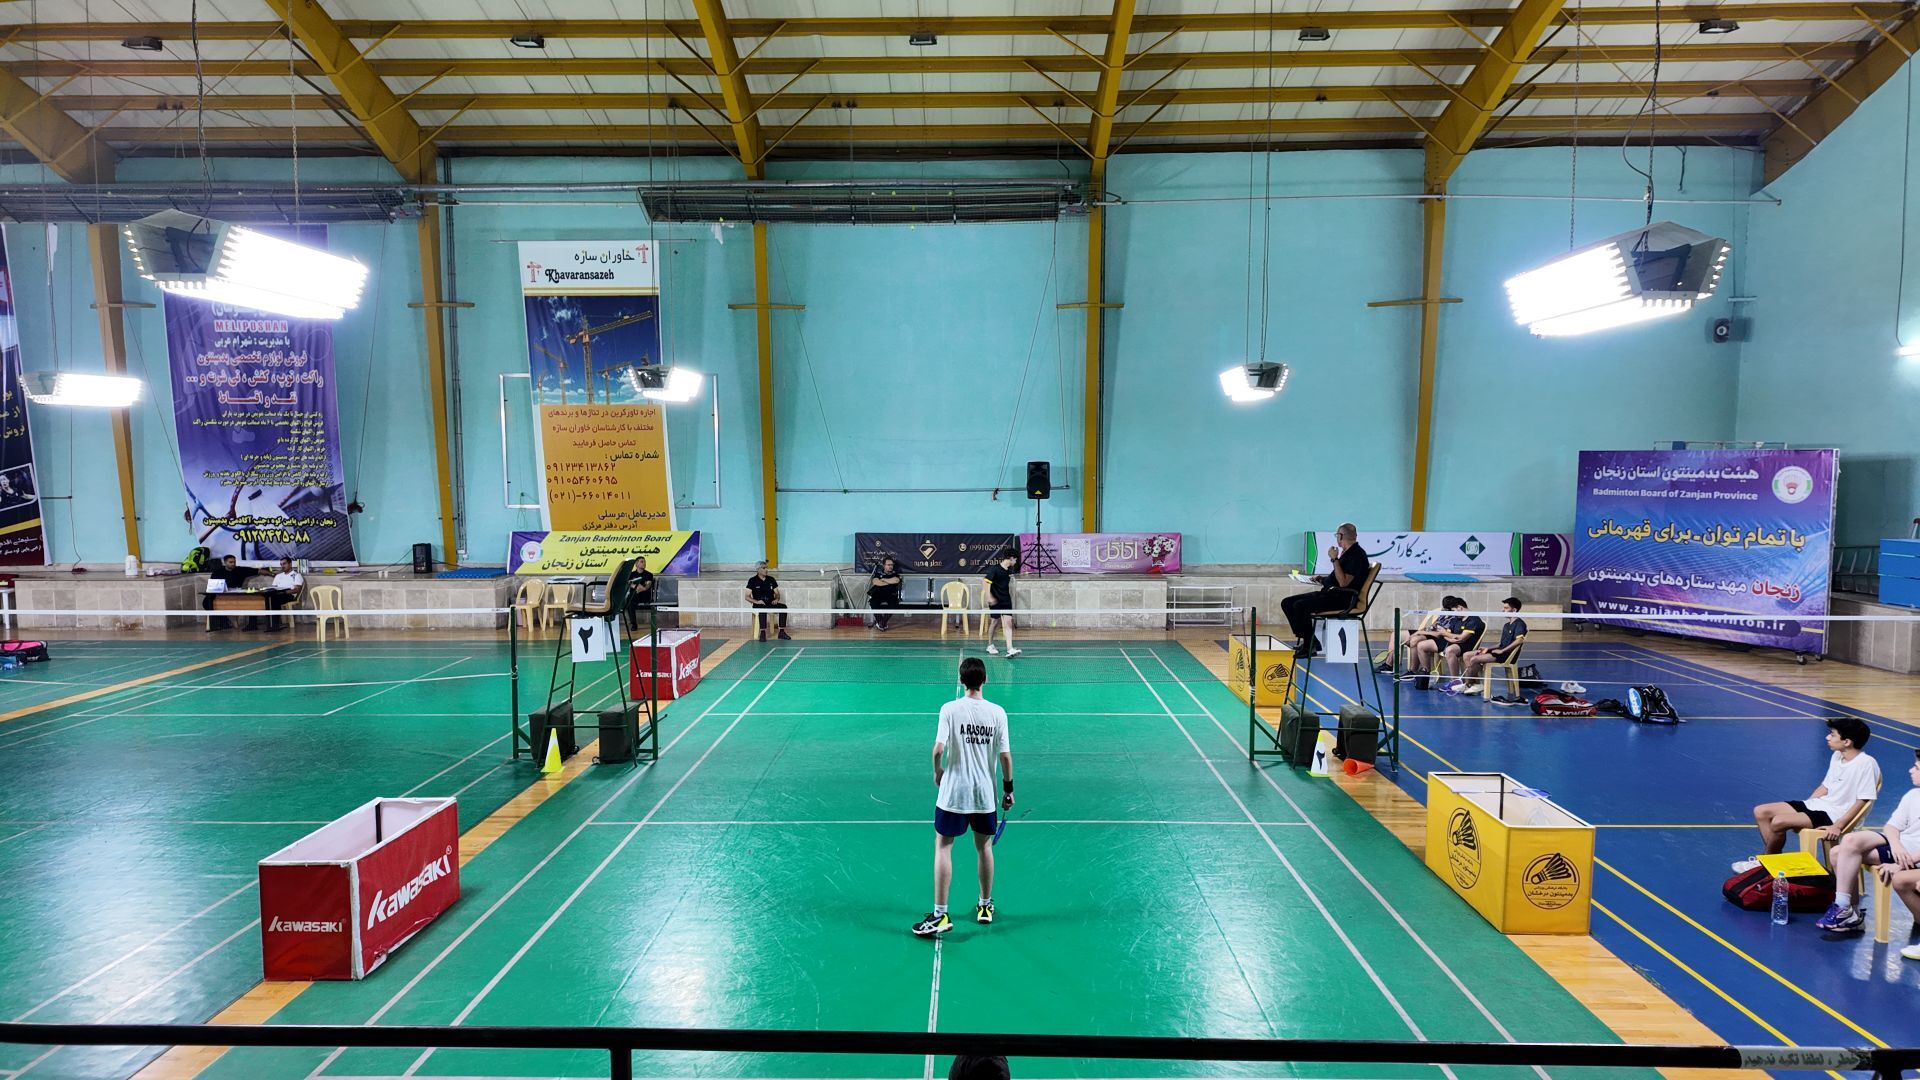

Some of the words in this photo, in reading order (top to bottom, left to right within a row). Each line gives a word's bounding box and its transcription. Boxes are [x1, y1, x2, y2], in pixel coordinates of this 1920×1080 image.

[574, 250, 597, 265] سازه
[600, 248, 635, 264] خاوران
[544, 268, 615, 283] Khavaransazeh
[214, 320, 288, 333] MELIPOSHAN
[196, 351, 230, 367] بدمینتون
[230, 350, 262, 366] تخصصی
[262, 350, 284, 367] لوازم
[284, 350, 308, 367] فروش
[199, 373, 206, 387] و
[206, 369, 227, 387] شرت
[227, 369, 240, 387] تی
[610, 451, 633, 461] تماس
[635, 450, 659, 462] شماره
[546, 462, 616, 472] ۰۹۱۲۳۴۱۳۸۶۲
[1593, 465, 1626, 481] زنجان
[1627, 465, 1660, 481] استان
[1661, 466, 1720, 483] بدمینتون
[1721, 466, 1760, 483] هیئت
[546, 476, 618, 485] ۰۹۱۰۵۴۶۰۶۹۵
[1593, 487, 1640, 497] Badminton
[1640, 488, 1667, 498] Board
[1668, 489, 1679, 498] of
[1679, 490, 1712, 500] Zanjan
[1713, 491, 1758, 501] Province
[582, 520, 602, 530] مرکزی
[603, 521, 618, 530] دفتر
[619, 520, 638, 530] آدرس
[1587, 518, 1651, 540] قهرمانی
[1654, 522, 1692, 544] برای
[233, 529, 311, 543] ۰۹۱۲۷۴۲۵۰۸۸
[559, 535, 591, 544] Zanjan
[592, 534, 643, 542] Badminton
[1702, 524, 1741, 547] توان
[1743, 527, 1787, 549] تمام
[1789, 529, 1806, 552] با
[580, 545, 629, 557] بدمینتون
[631, 544, 661, 555] هیئت
[542, 558, 574, 571] زنجان
[575, 558, 608, 569] استان
[1587, 567, 1646, 586] بدمینتون
[1716, 578, 1747, 594] مهد
[1752, 577, 1801, 602] زنجان
[1598, 601, 1786, 631] www.zanjanbdminton.ir
[578, 625, 594, 654] ۲
[1338, 626, 1347, 657] ۱
